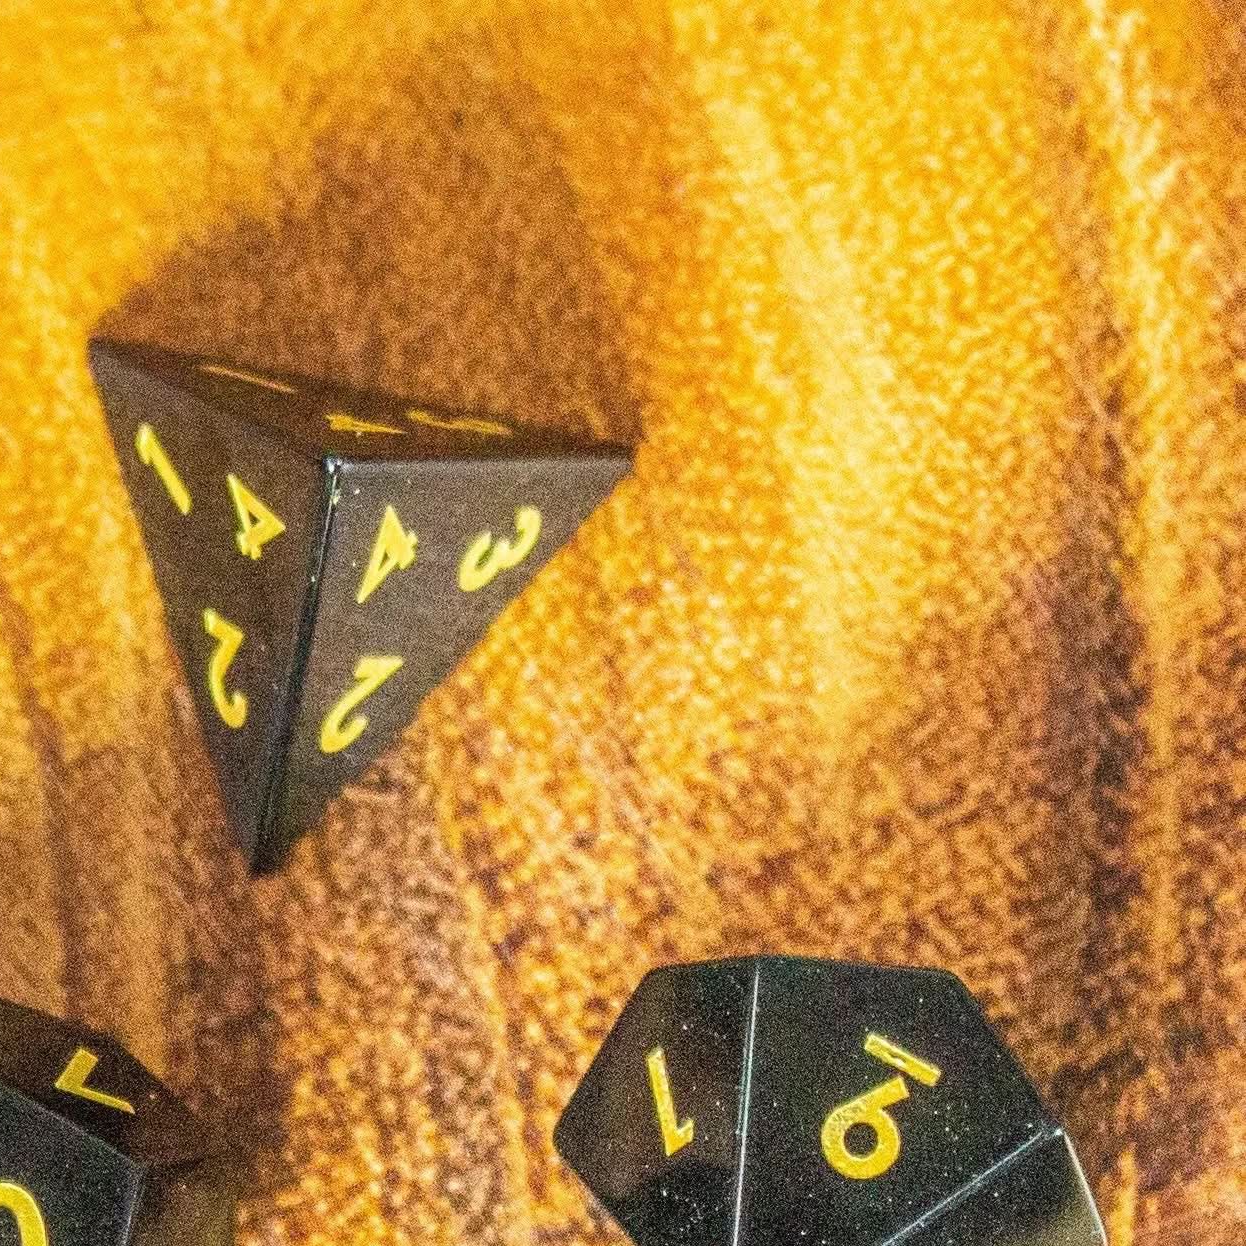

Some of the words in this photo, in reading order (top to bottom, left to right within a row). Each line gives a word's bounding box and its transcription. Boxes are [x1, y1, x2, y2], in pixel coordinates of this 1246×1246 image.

[136, 424, 191, 515] 1
[228, 474, 285, 559] 4
[357, 505, 417, 603] 4
[459, 505, 540, 590] 3
[204, 610, 246, 728] 2
[320, 657, 402, 753] 2
[55, 1048, 134, 1114] 7
[647, 1047, 693, 1156] 1
